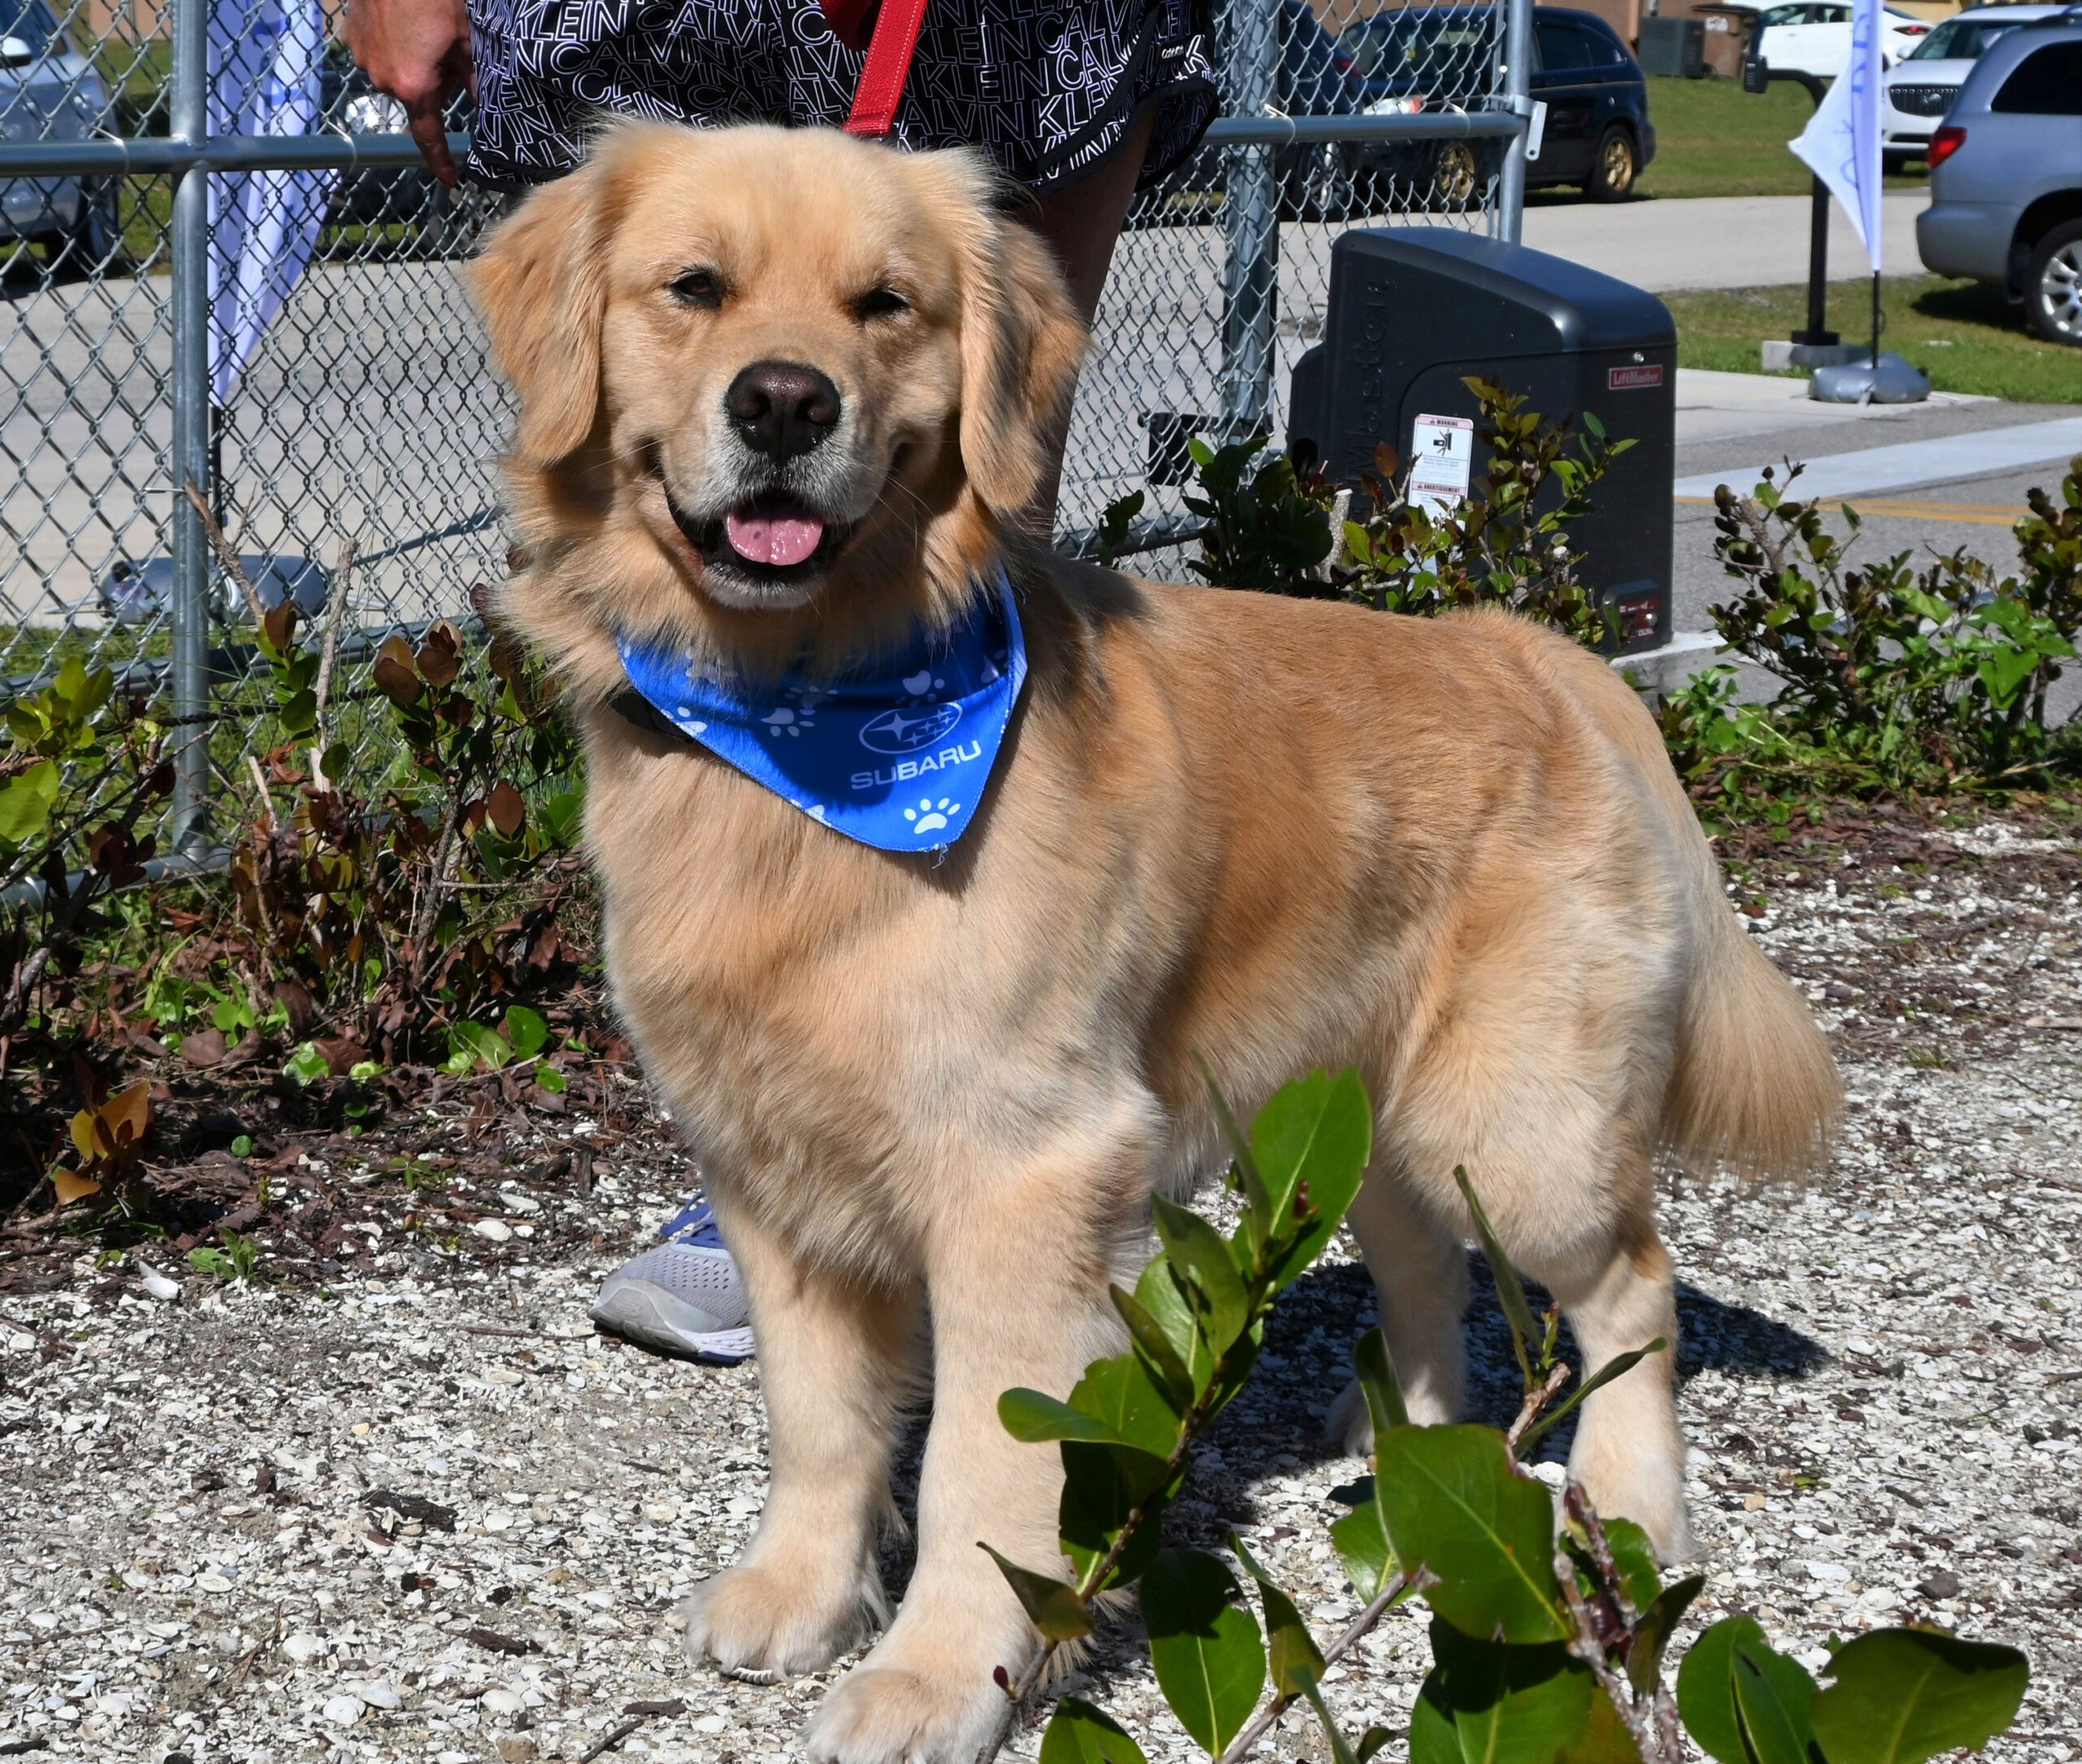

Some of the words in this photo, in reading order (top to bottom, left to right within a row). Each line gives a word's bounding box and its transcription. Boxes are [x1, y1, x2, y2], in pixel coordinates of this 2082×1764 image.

[509, 1, 628, 41] KLEIN
[550, 33, 726, 75] CALVIN
[573, 62, 746, 105] CALVIN
[919, 57, 1050, 104] KLEIN
[894, 98, 1026, 142] ALVIN
[1613, 370, 1659, 385] LiftMaster
[850, 740, 982, 790] SUBARU
